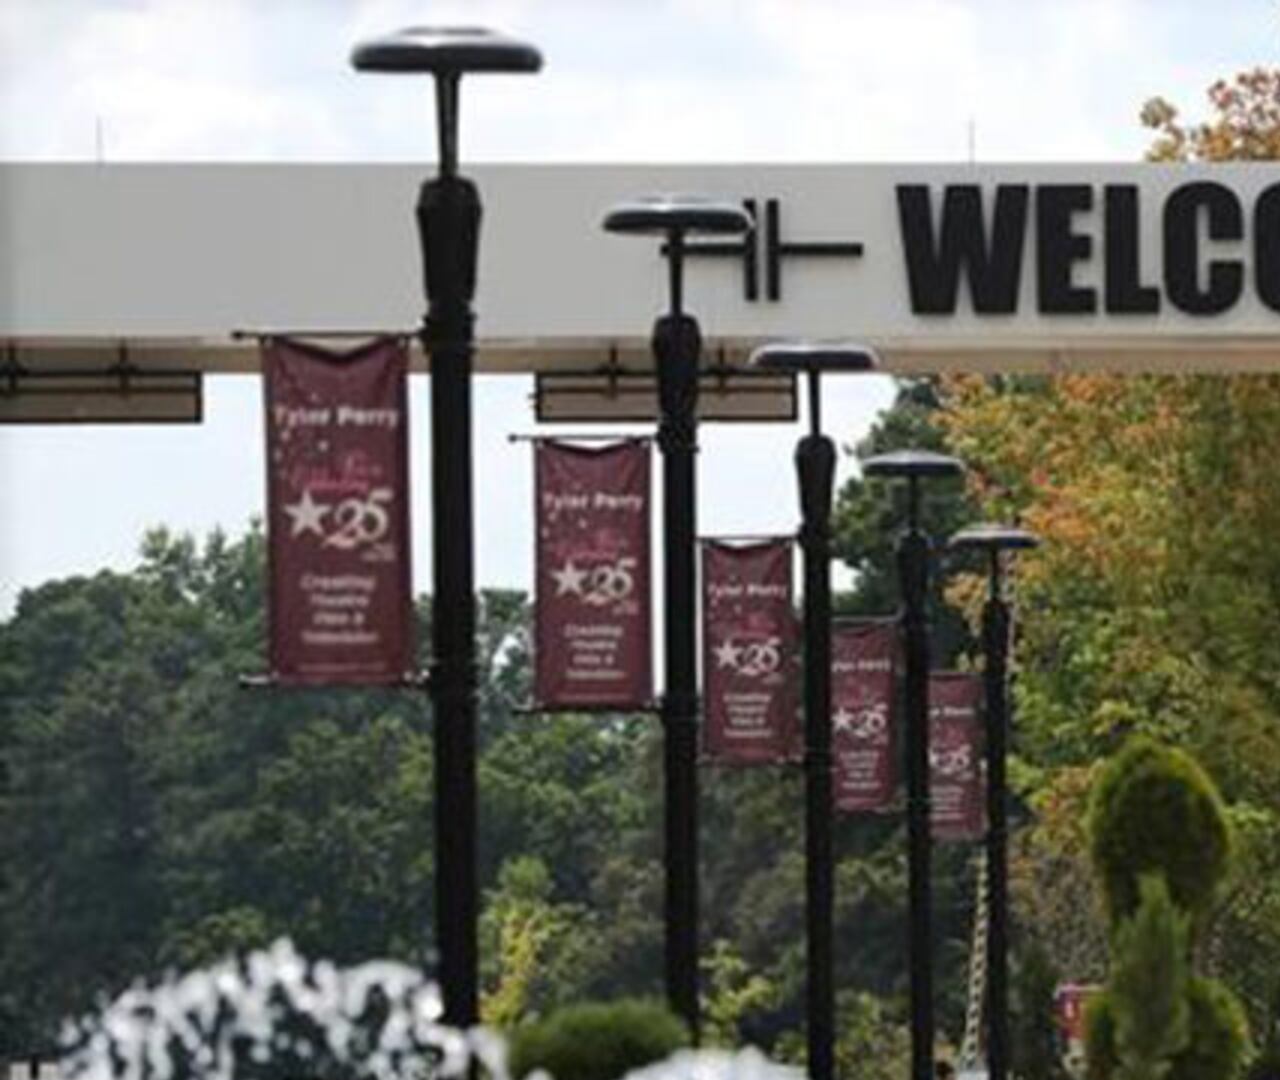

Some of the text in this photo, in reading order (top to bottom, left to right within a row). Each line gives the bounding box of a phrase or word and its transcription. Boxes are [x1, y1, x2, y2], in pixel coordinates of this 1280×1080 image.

[273, 405, 399, 429] Tyler Perry
[321, 487, 394, 549] 25
[584, 557, 638, 606] 25
